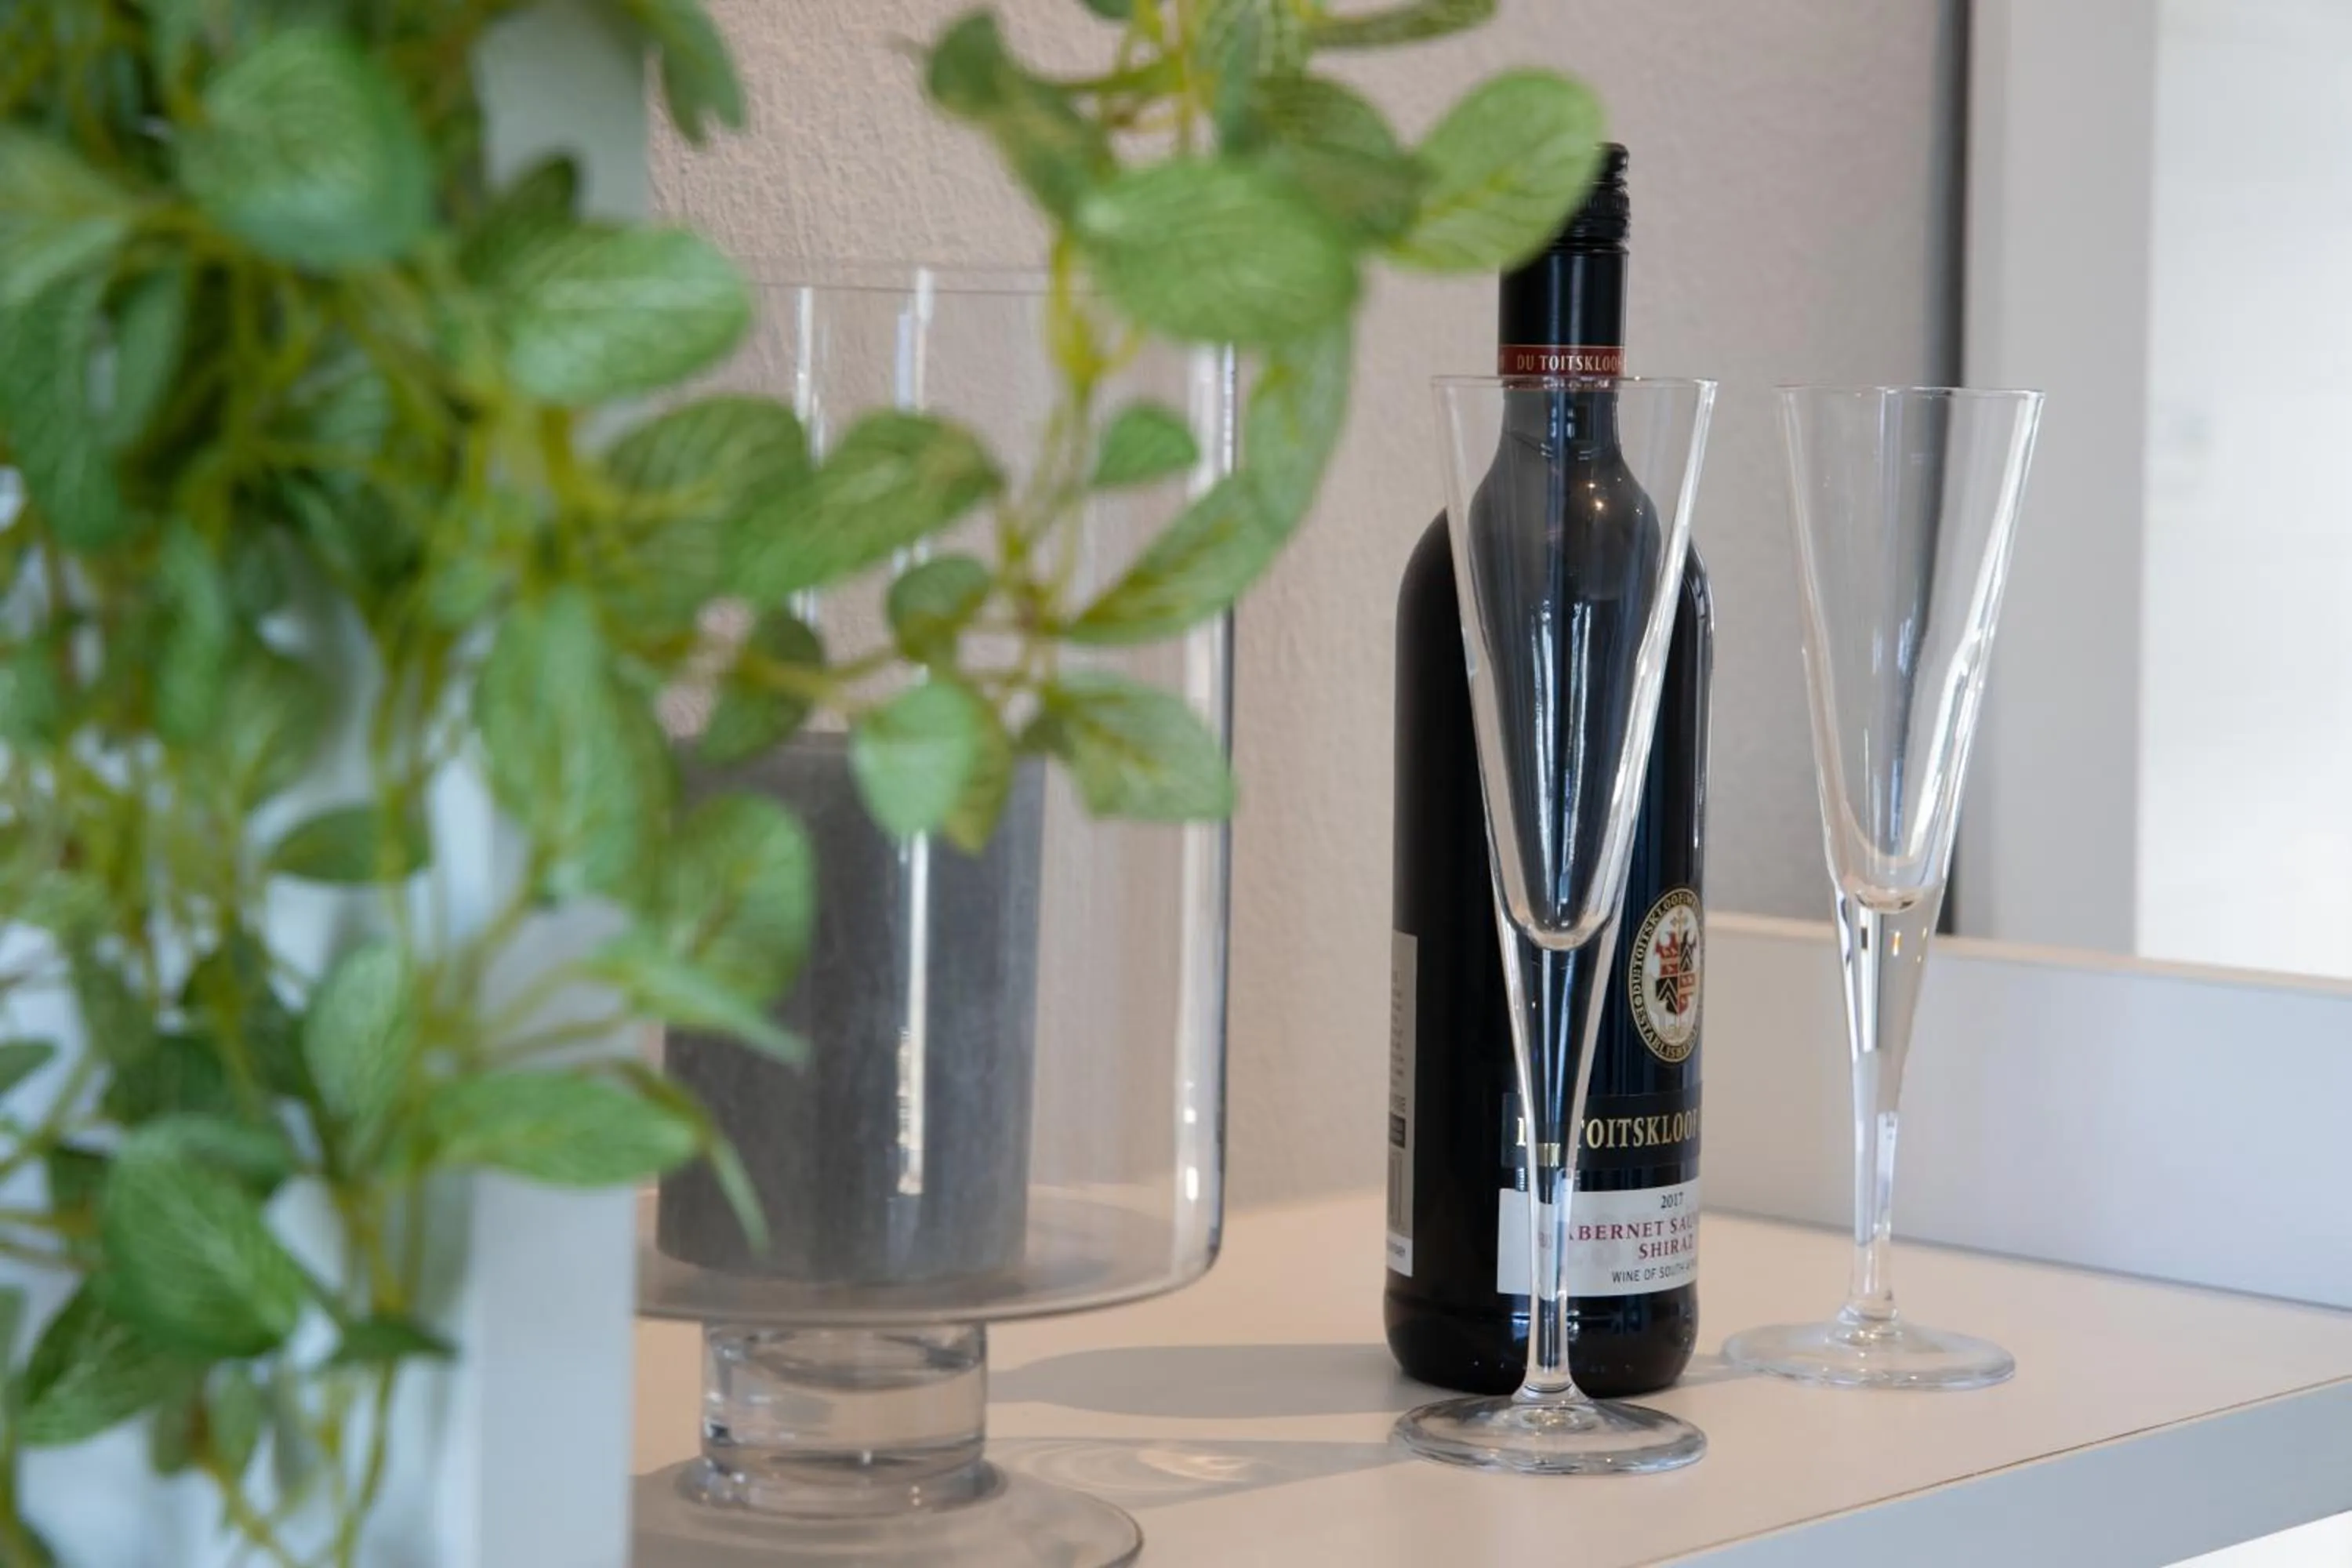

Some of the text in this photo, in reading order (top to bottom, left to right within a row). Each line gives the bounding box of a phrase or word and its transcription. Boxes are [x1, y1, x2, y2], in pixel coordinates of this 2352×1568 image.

[1517, 354, 1534, 371] DU
[1661, 1192, 1683, 1209] 2017
[1569, 1221, 1664, 1241] BERNET
[1639, 1234, 1693, 1260] SHIRAZ
[1612, 1269, 1639, 1283] WINE
[1644, 1268, 1656, 1280] OF
